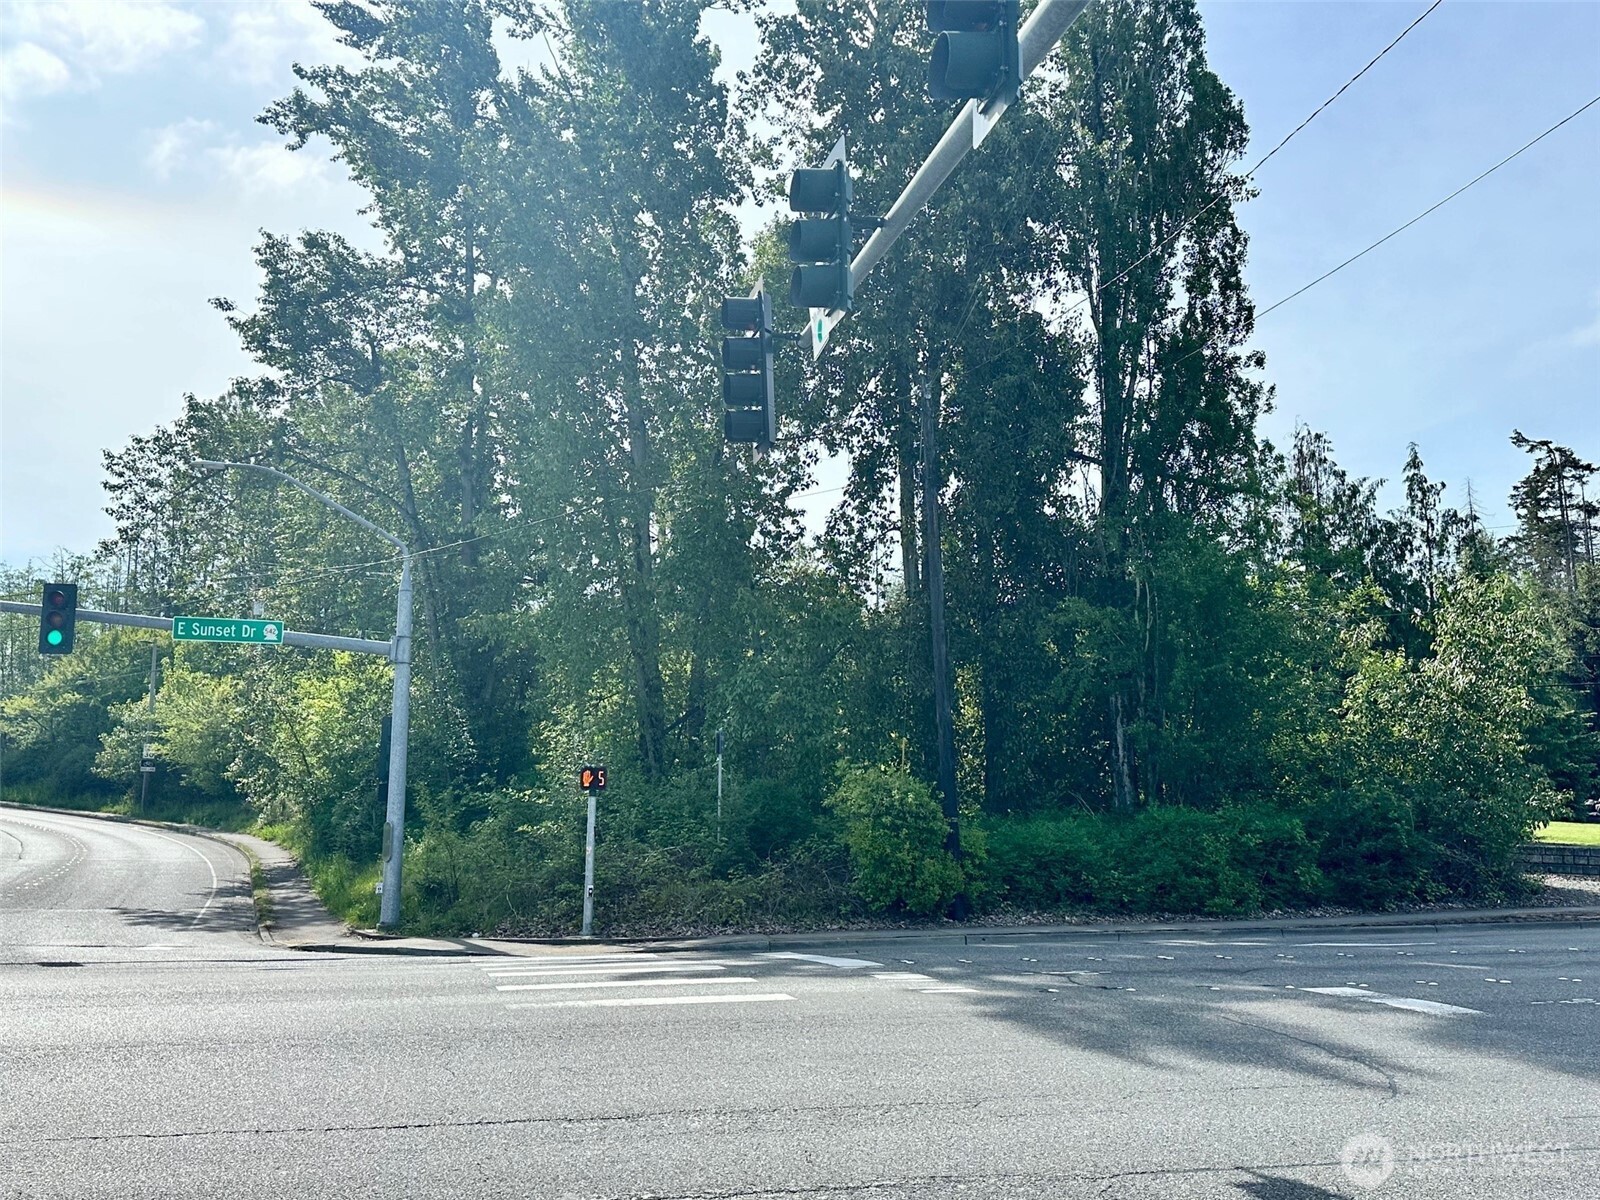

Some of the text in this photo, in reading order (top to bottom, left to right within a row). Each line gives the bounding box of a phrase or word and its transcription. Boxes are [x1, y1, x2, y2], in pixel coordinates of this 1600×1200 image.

[177, 622, 186, 635] E
[191, 622, 236, 637] Sunset
[241, 624, 256, 638] Dr
[598, 770, 605, 786] 5
